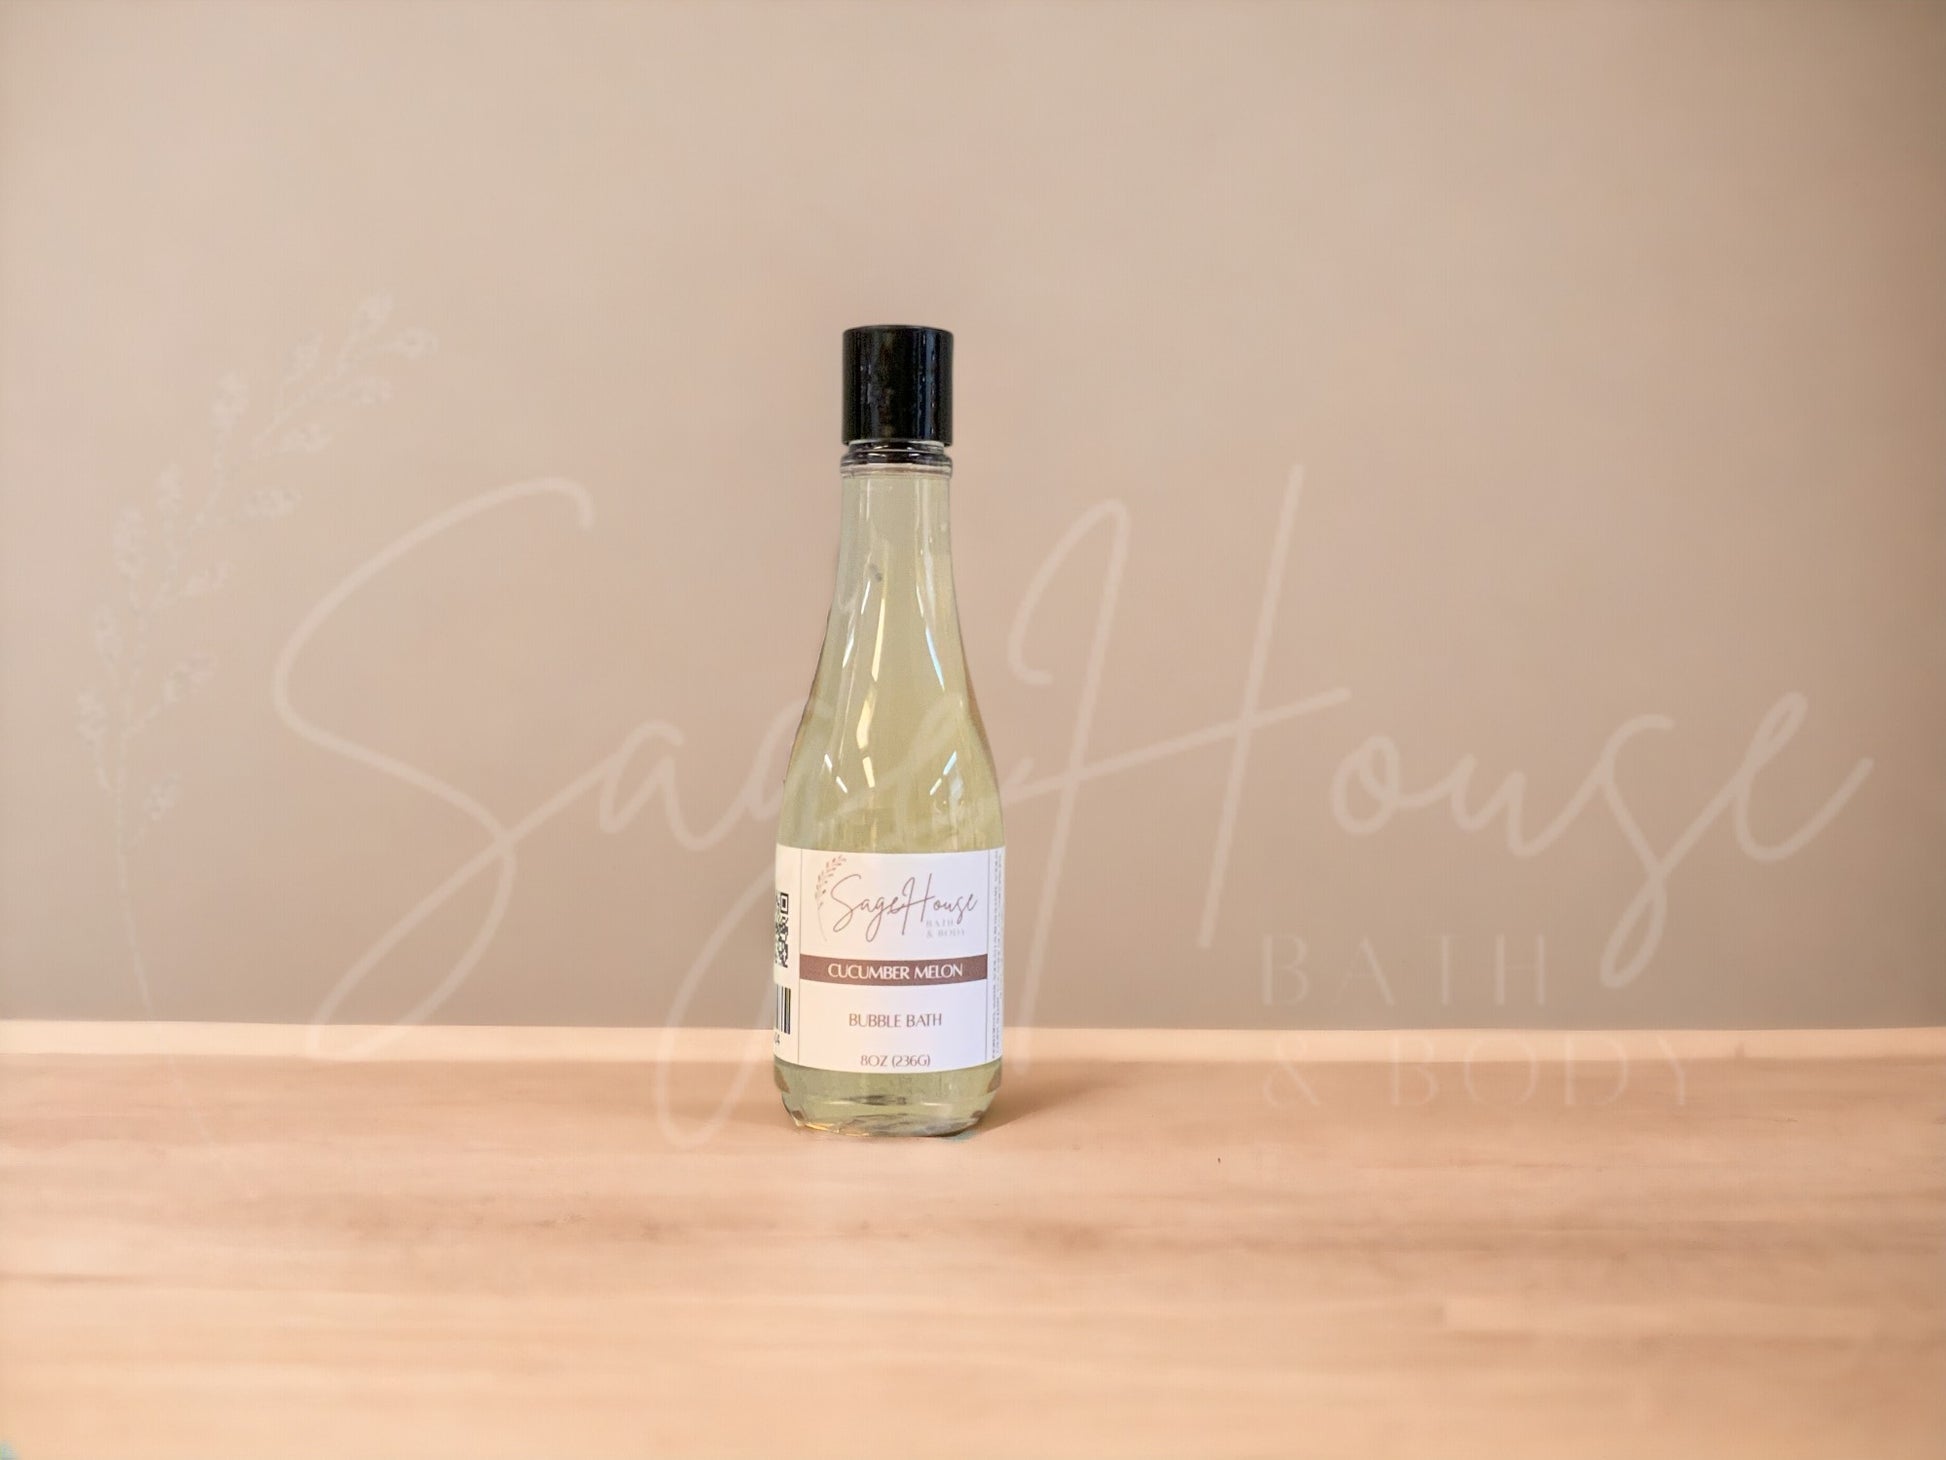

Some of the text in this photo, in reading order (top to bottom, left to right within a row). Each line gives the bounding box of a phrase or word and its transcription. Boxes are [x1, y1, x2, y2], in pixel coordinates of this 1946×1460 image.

[827, 963, 965, 980] CUCUMBER MELON
[848, 1013, 943, 1028] BUBBLE BATH
[860, 1054, 931, 1067] 8OZ (236G)
